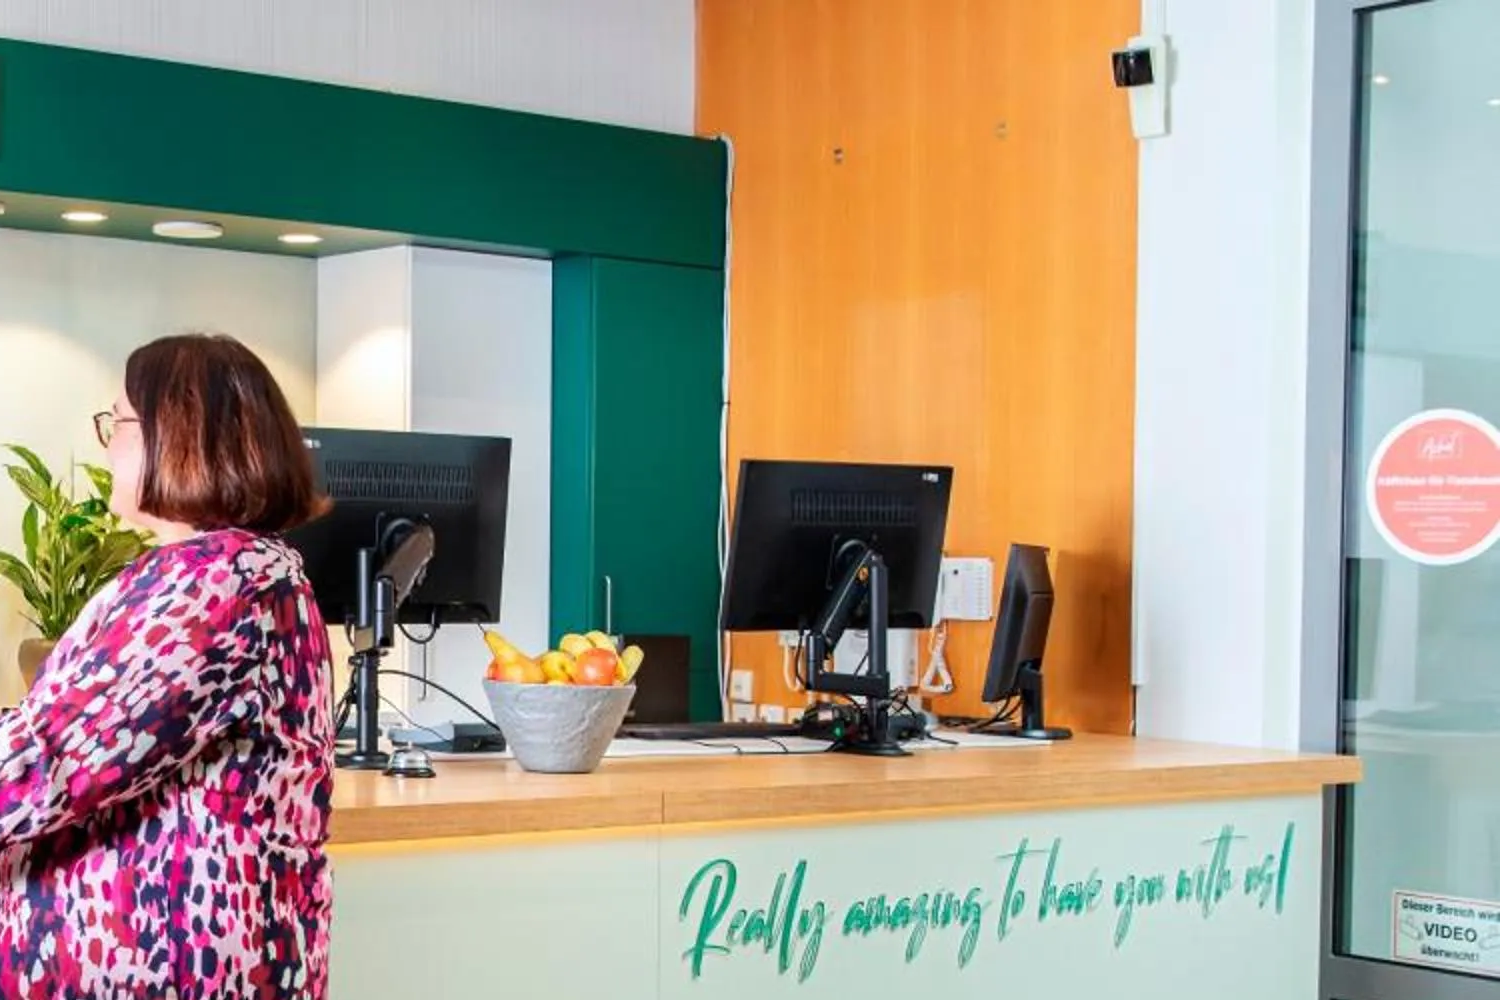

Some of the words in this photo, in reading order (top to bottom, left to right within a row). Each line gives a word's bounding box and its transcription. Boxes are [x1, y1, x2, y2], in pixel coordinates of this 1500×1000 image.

[679, 858, 833, 985] Really
[842, 885, 992, 970] amazing
[995, 837, 1048, 941] to
[1037, 837, 1104, 922] have
[1113, 873, 1167, 949] you
[1175, 824, 1249, 919] with
[1402, 899, 1433, 913] Dieser
[1435, 904, 1475, 918] Bereich
[1423, 923, 1477, 943] VIDEO
